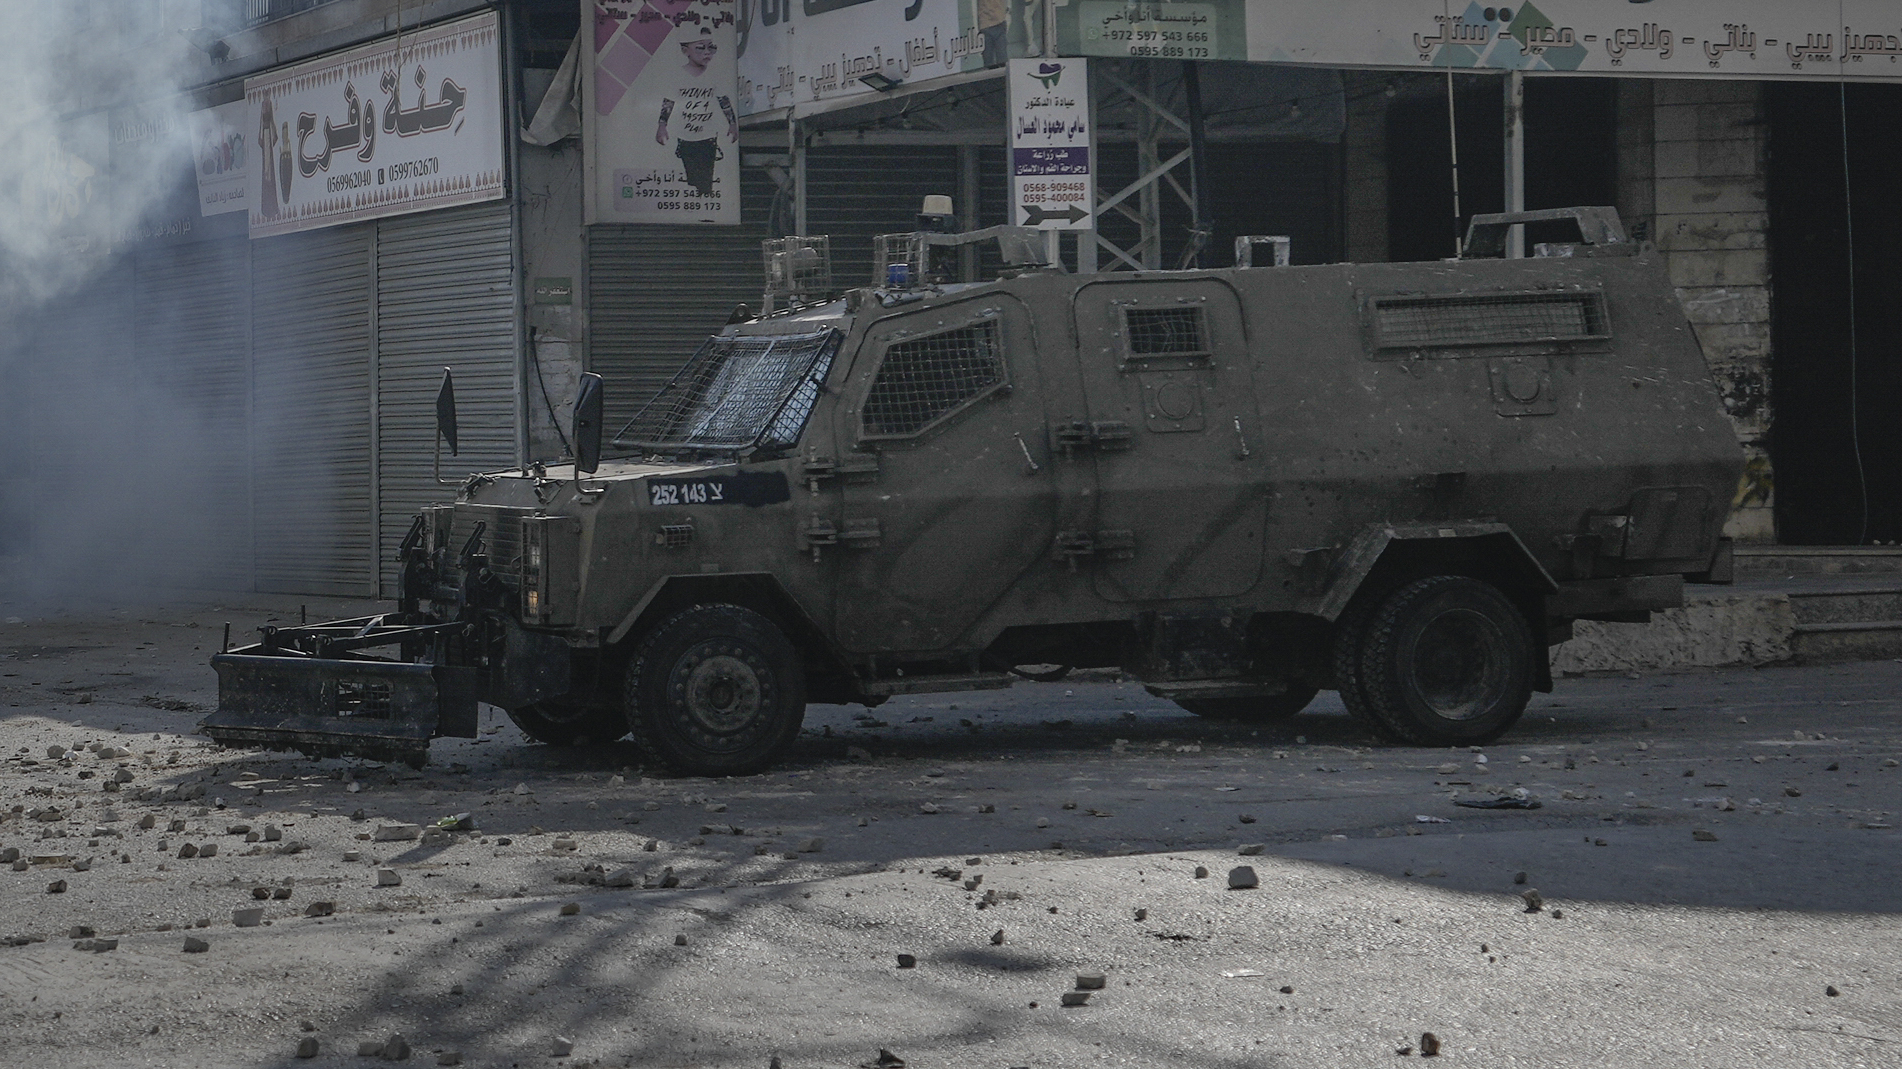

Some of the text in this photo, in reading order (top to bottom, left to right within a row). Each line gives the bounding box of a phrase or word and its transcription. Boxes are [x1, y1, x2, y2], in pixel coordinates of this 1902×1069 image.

[1152, 8, 1207, 26] مؤسسة
[1102, 30, 1208, 41] +972 597 543 666
[1413, 15, 1490, 62] ستاتي
[1605, 23, 1674, 66] ولادي
[1703, 23, 1757, 68] بناتي
[1839, 26, 1902, 64] جهيز
[898, 26, 940, 79] أطفال
[1130, 46, 1209, 57] 0595 889 173
[1786, 33, 1834, 70] بيبي
[388, 157, 439, 181] 0599762670
[664, 170, 675, 182] أنا
[635, 189, 660, 198] +972
[663, 189, 680, 198] 597
[1023, 183, 1085, 192] 0568-909468
[657, 201, 721, 211] 0595 889 173
[1023, 193, 1085, 203] 0595-400084
[651, 484, 679, 505] 252
[681, 483, 707, 503] 143
